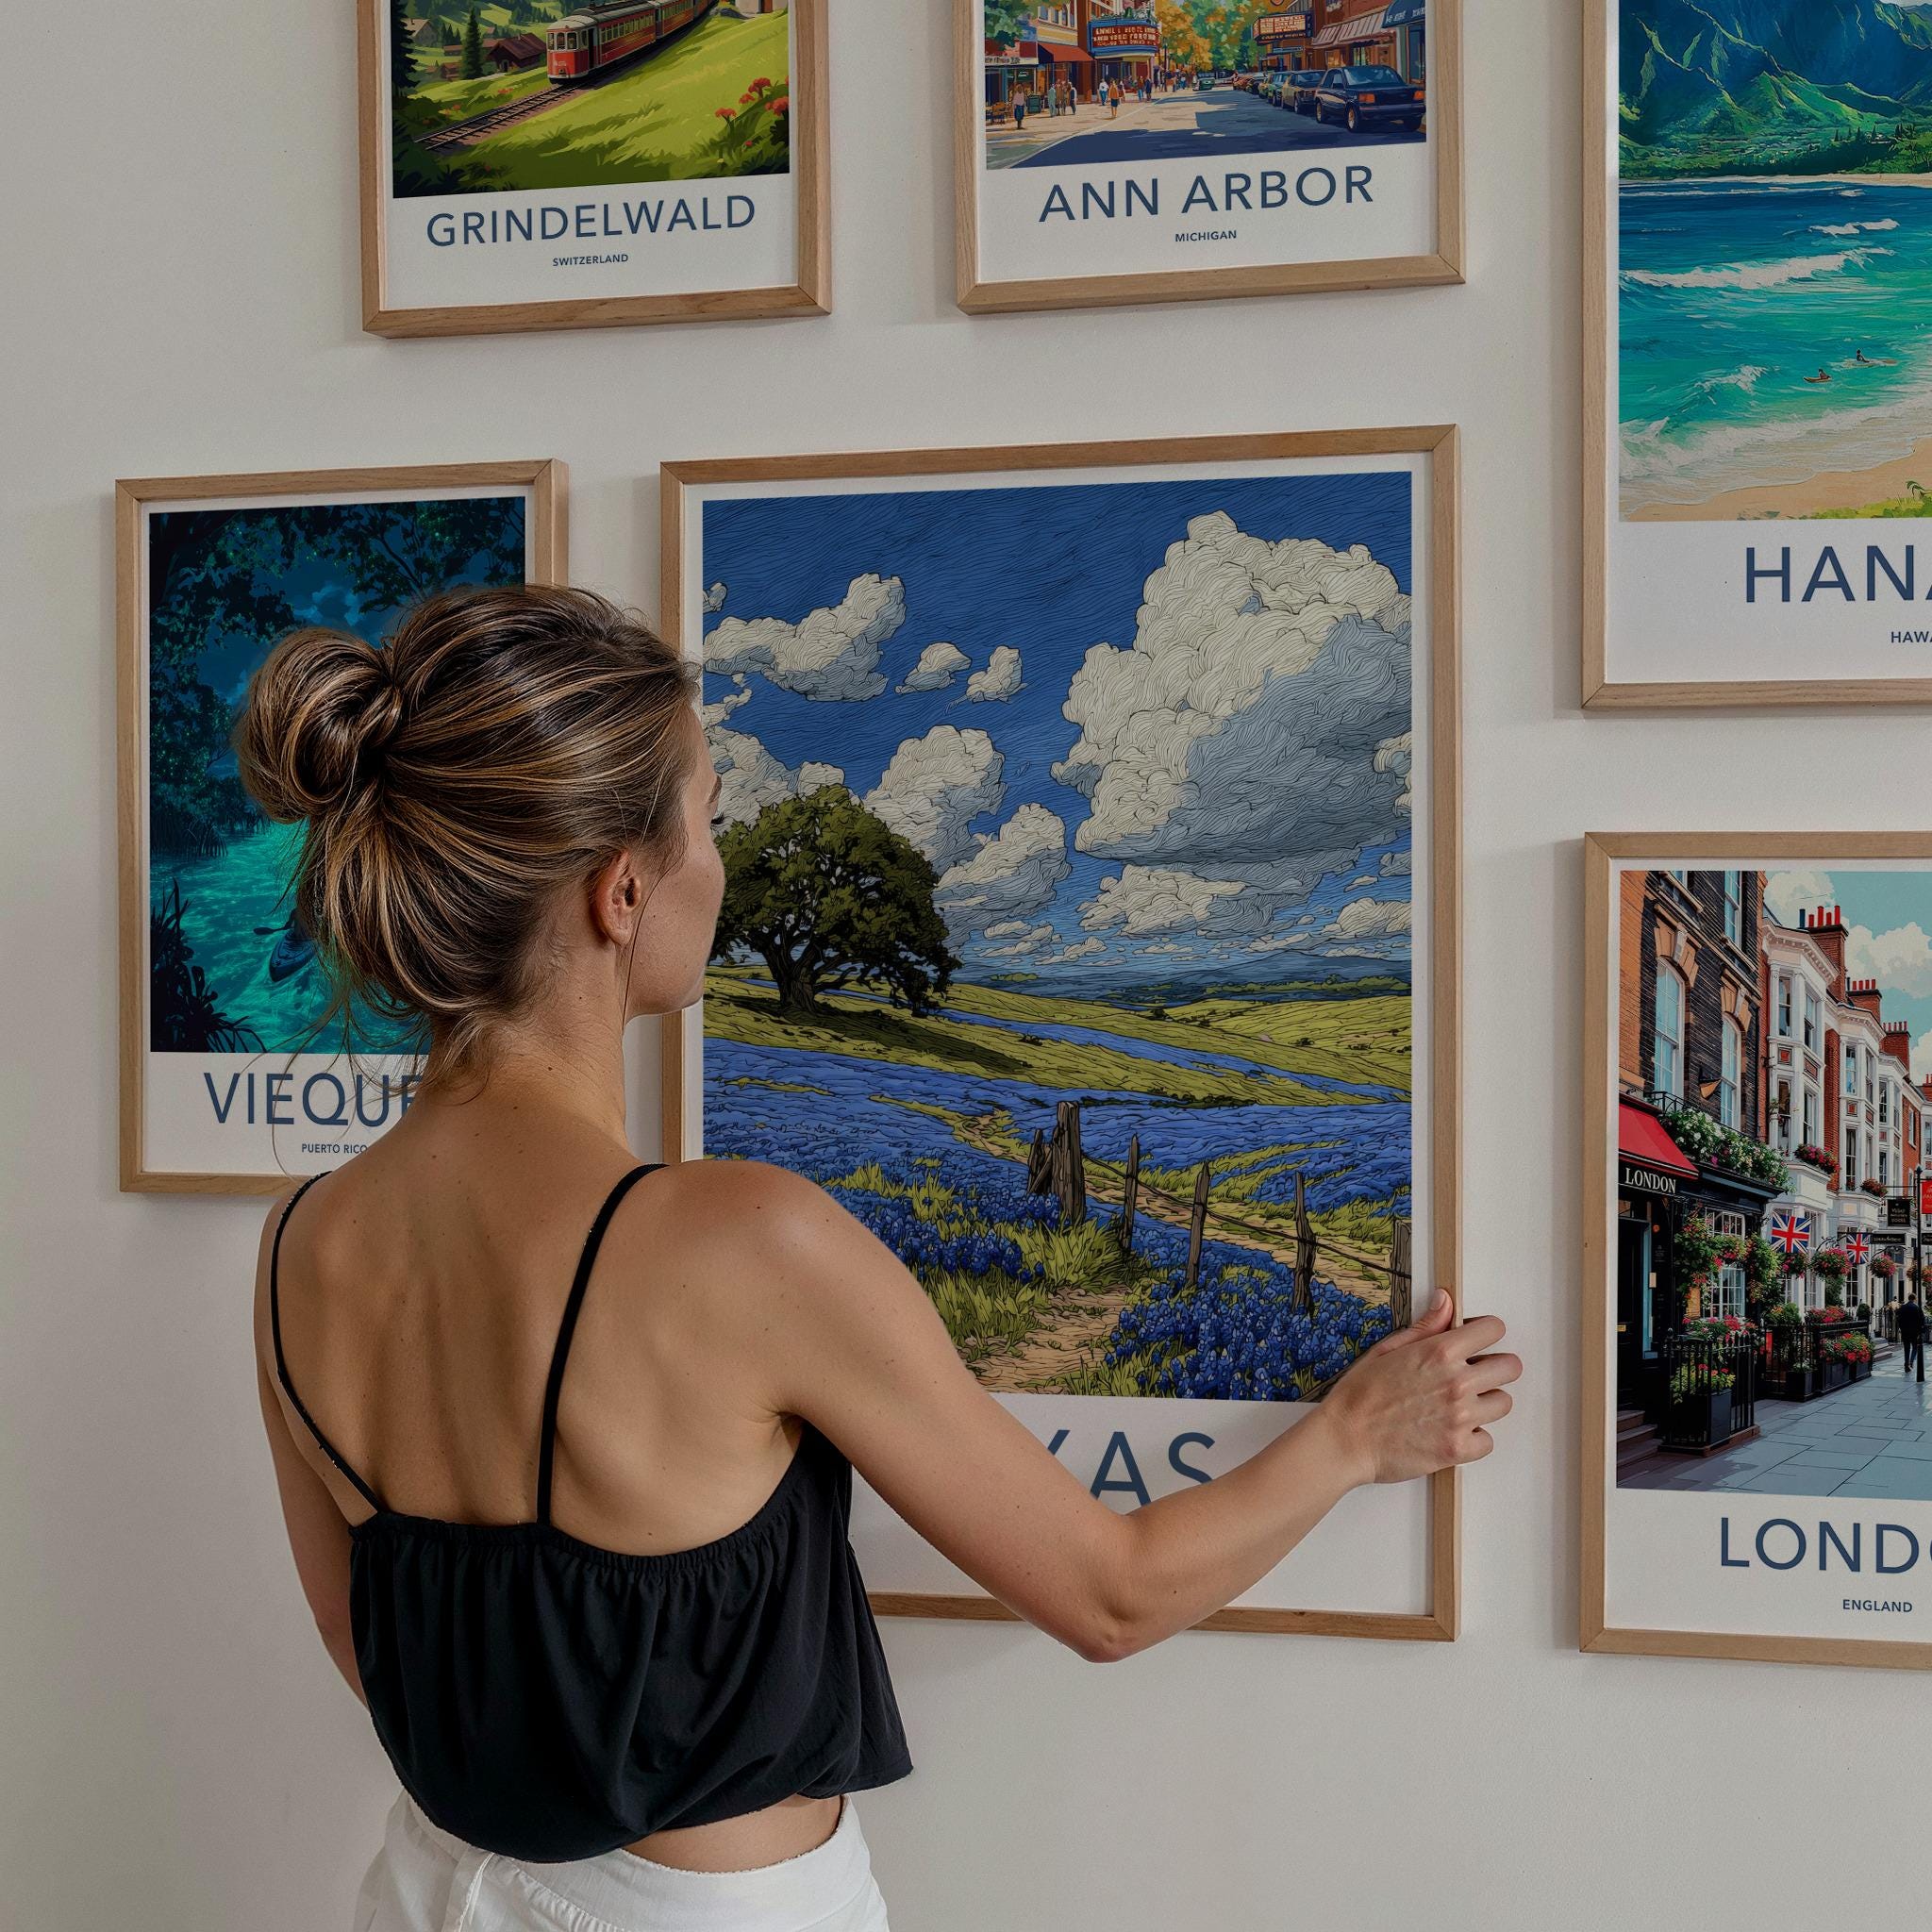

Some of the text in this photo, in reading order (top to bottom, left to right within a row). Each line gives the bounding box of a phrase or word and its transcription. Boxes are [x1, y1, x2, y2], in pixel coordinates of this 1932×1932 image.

[1039, 165, 1374, 223] ANN ARBOR
[427, 194, 756, 247] GRINDELWALD
[1174, 229, 1237, 242] MICHIGAN
[552, 254, 629, 267] SWITZERLAND
[1746, 544, 1932, 603] HAN
[1890, 630, 1932, 643] HAW
[301, 1142, 368, 1154] PUERTO RICO
[1624, 1167, 1676, 1194] LONDON
[1721, 1517, 1932, 1574] LOND
[1842, 1598, 1913, 1613] ENGLAND
